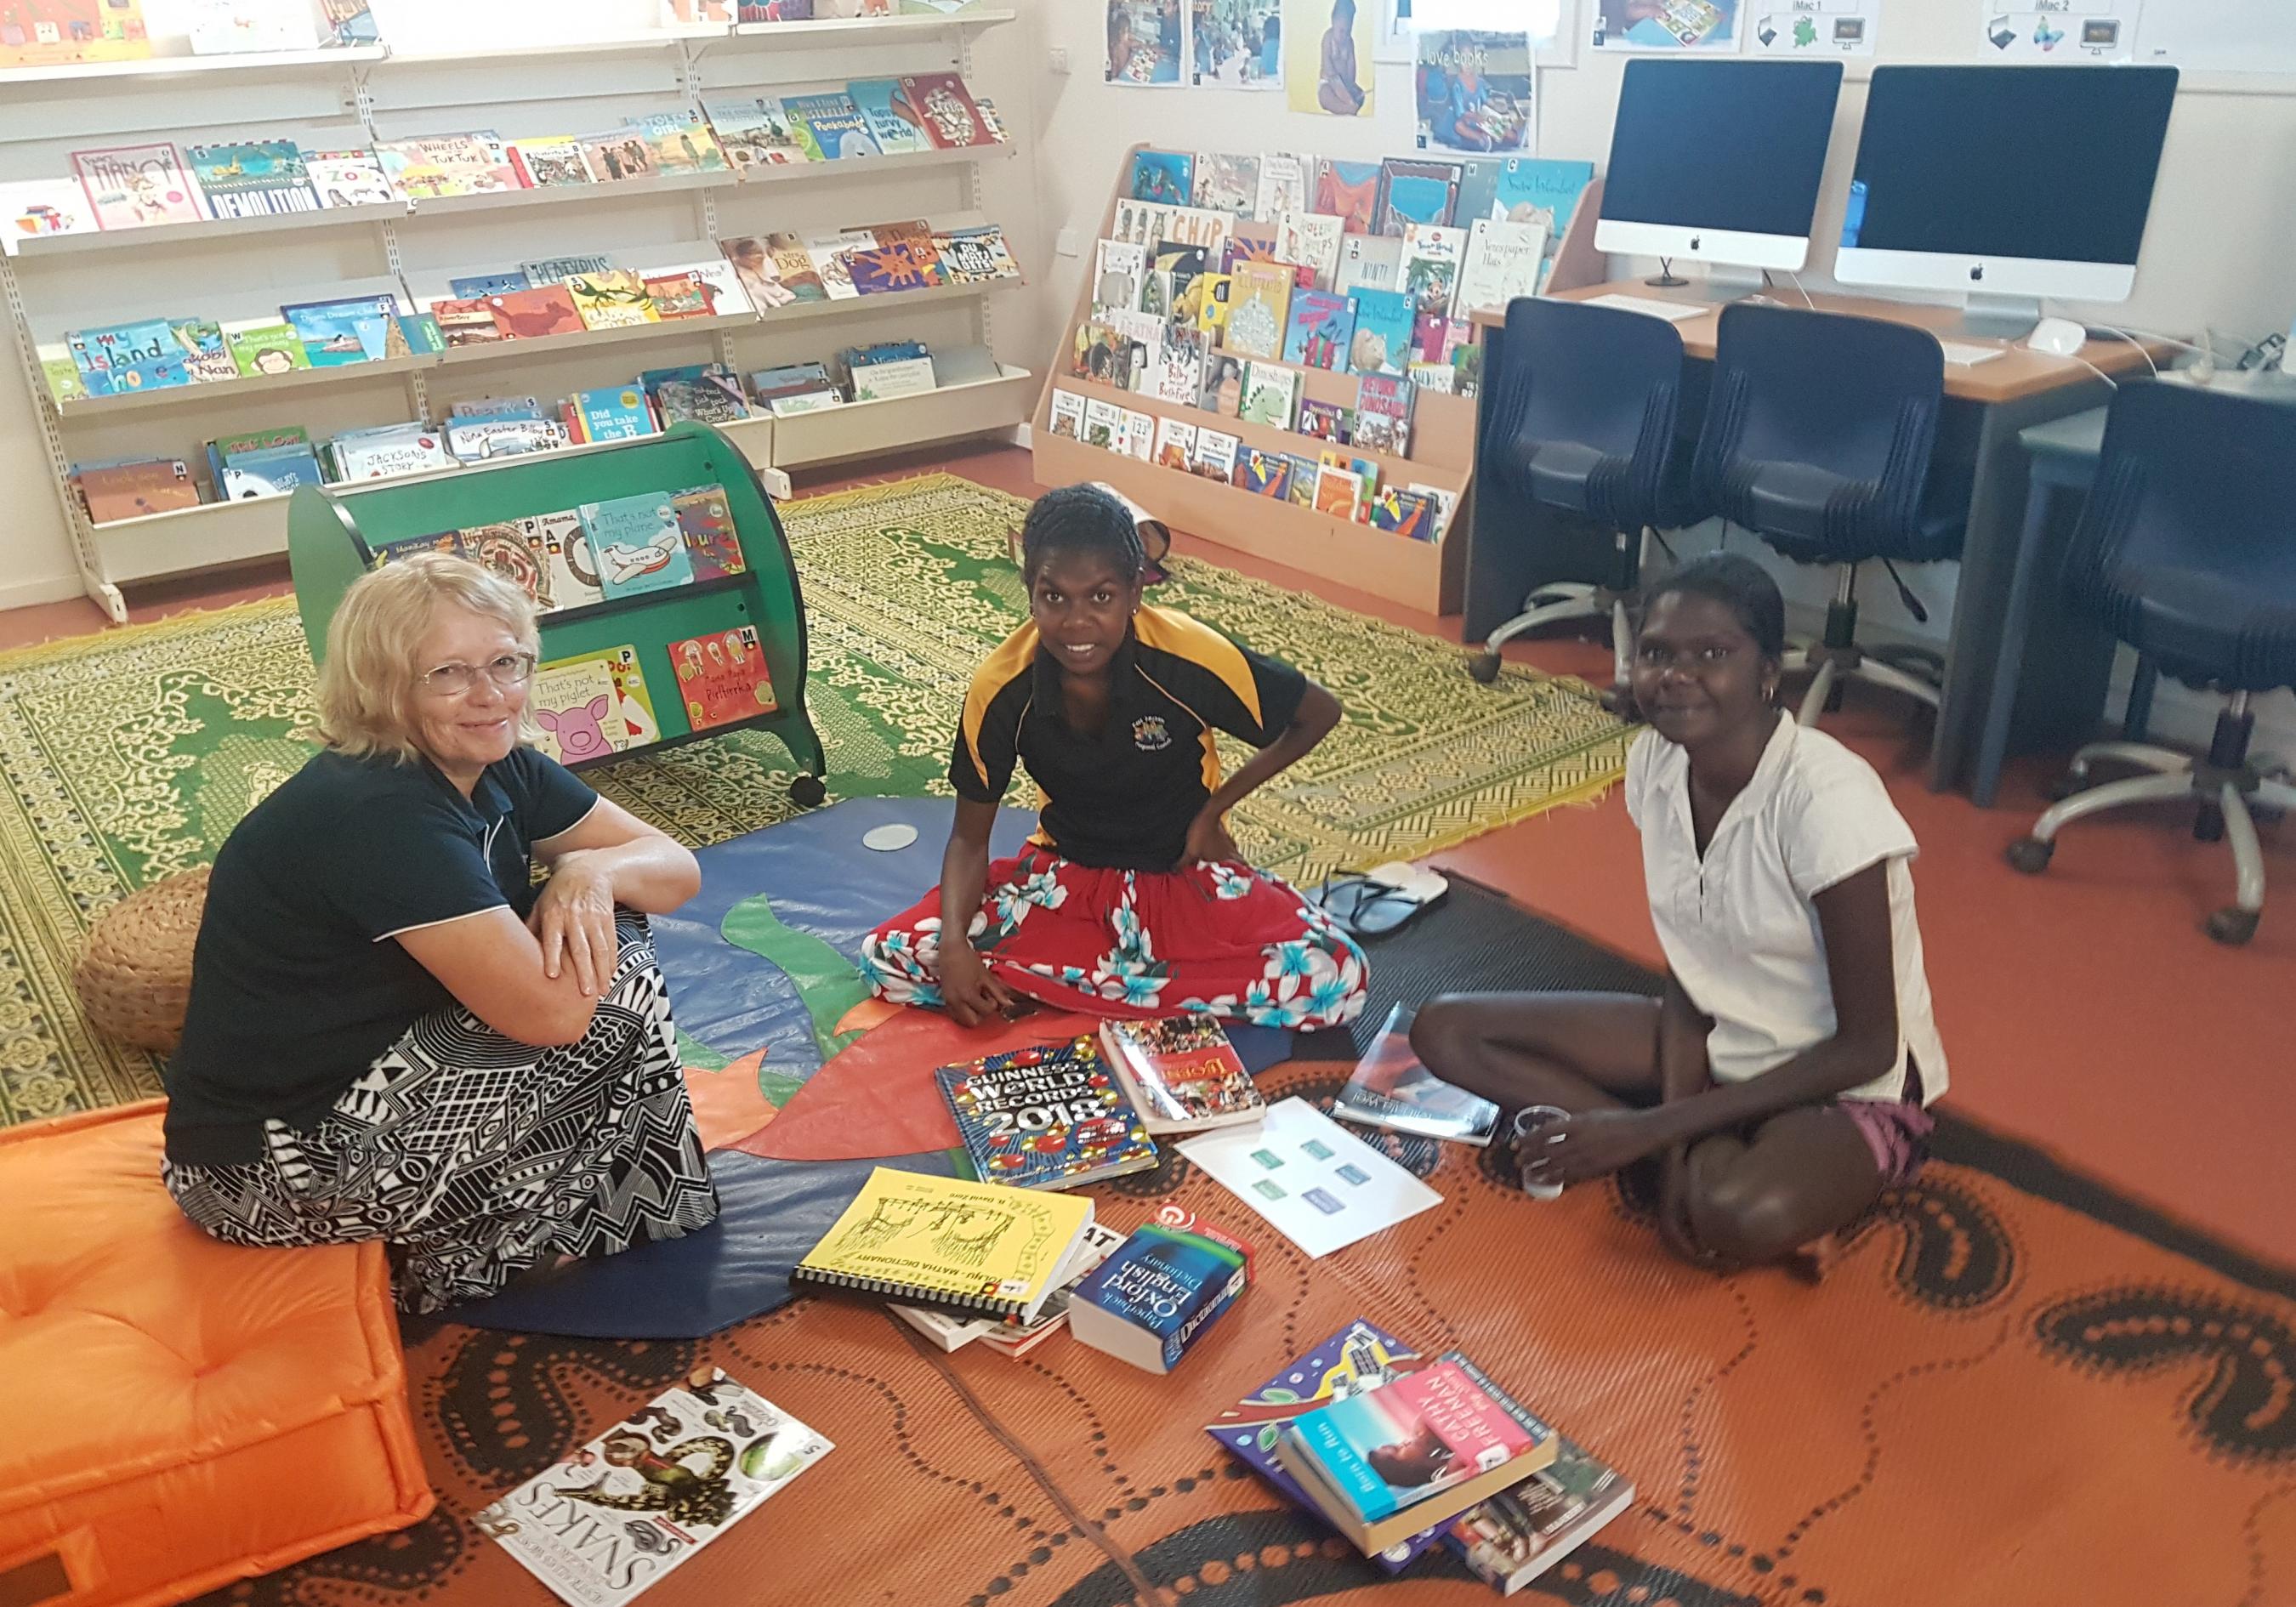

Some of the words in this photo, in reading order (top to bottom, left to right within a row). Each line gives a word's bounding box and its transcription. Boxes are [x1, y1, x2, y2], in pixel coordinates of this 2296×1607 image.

[1427, 48, 1450, 66] love
[1452, 45, 1489, 65] books
[418, 140, 469, 152] WHEELS
[775, 254, 810, 270] Dog
[590, 408, 611, 422] Did
[594, 419, 613, 431] you
[614, 414, 639, 426] take
[604, 430, 622, 440] the
[526, 520, 535, 534] P
[601, 511, 635, 526] That's
[638, 508, 656, 520] not
[546, 529, 556, 542] A
[605, 529, 622, 540] my
[625, 520, 655, 537] plane
[742, 629, 754, 642] M
[622, 650, 631, 663] P
[537, 679, 572, 696] That's
[575, 674, 594, 688] not
[538, 696, 558, 709] my
[965, 1061, 1080, 1088] GUINNESS
[969, 1072, 1086, 1101] WORLD
[975, 1084, 1094, 1114] RECORDS
[984, 1099, 1107, 1138] 2018
[855, 1253, 921, 1269] DICTIONARY
[922, 1262, 960, 1276] MATHA
[1141, 1253, 1203, 1292] Dictionary
[1121, 1259, 1193, 1307] English
[1102, 1273, 1178, 1318] Oxford
[1102, 1291, 1165, 1331] Paperback
[1417, 1395, 1470, 1443] CATHY
[1425, 1376, 1502, 1446] FREEMAN
[1317, 1421, 1340, 1451] Run
[1337, 1447, 1353, 1463] to
[1350, 1462, 1377, 1494] Born
[514, 1481, 656, 1590] SNAKES
